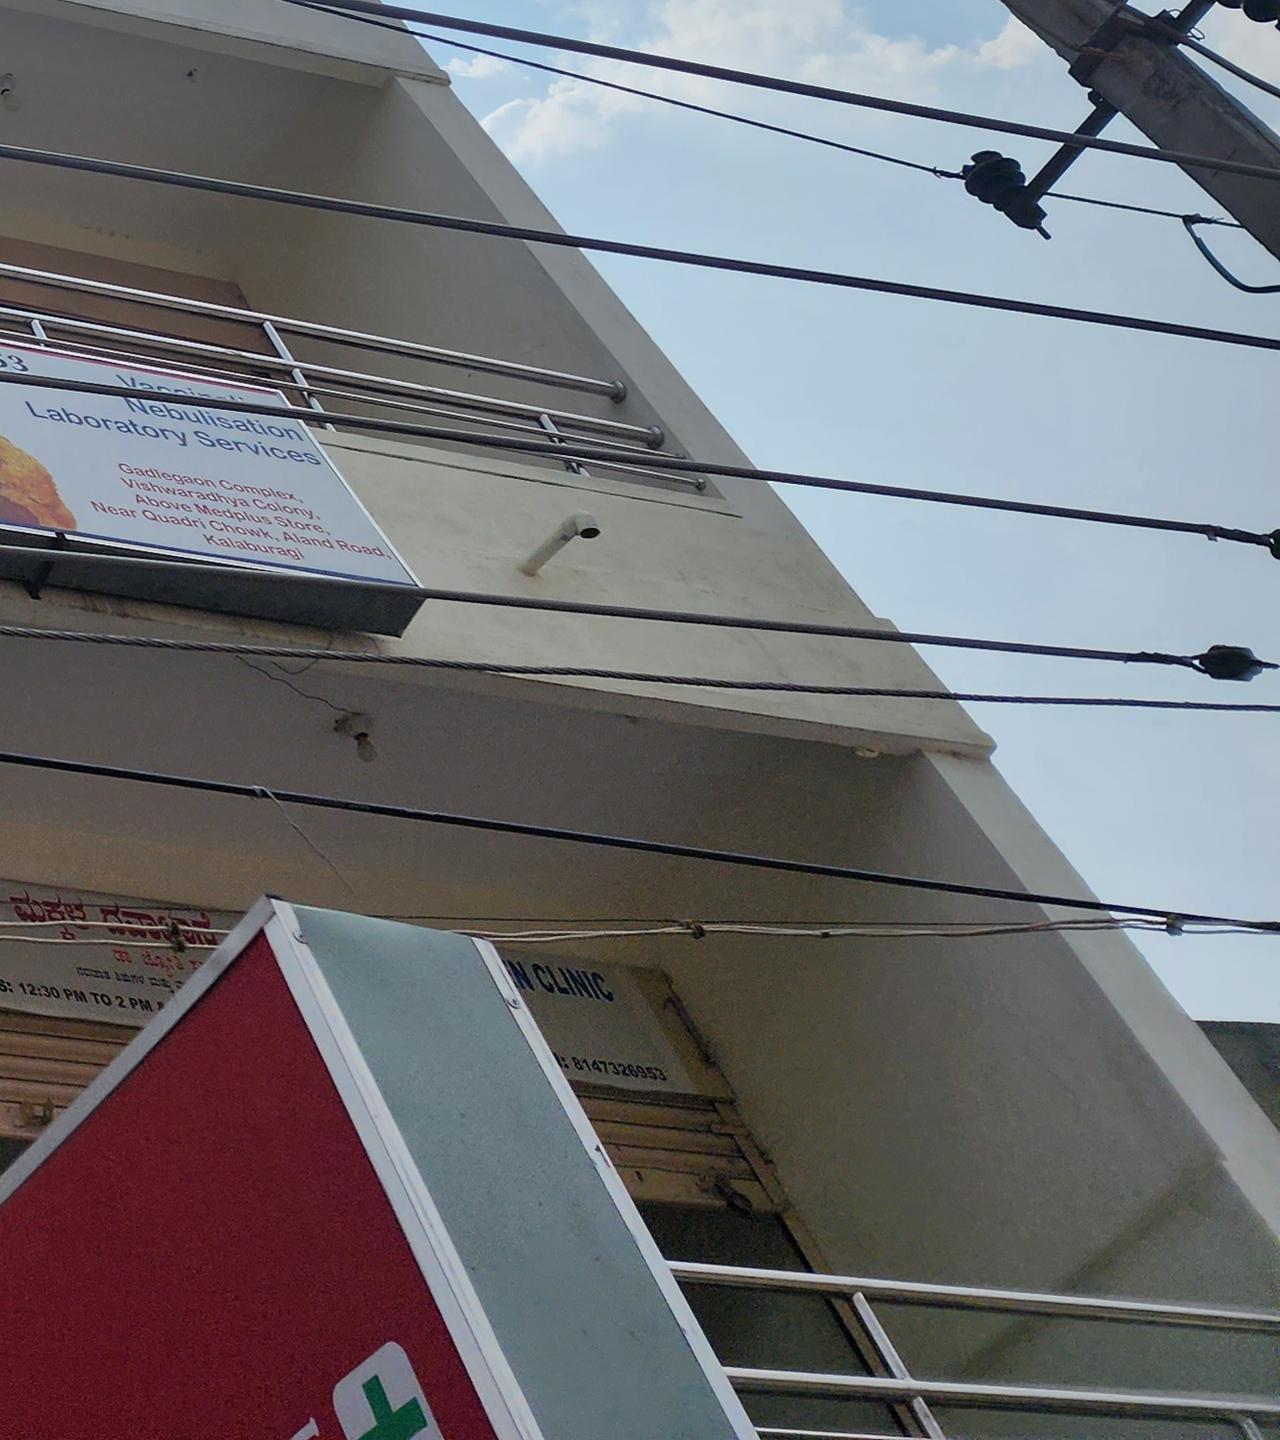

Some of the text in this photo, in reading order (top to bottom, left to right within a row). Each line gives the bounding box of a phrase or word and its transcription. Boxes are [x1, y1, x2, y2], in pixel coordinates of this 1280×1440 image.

[24, 400, 321, 466] Laboratory Services
[124, 397, 304, 442] Nebulisation
[118, 463, 304, 504] Gadlegaon Complex,
[120, 476, 321, 521] Vishwaradhya Colony,
[90, 500, 137, 519] Near
[142, 509, 207, 530] Quadri
[209, 519, 280, 542] Chowk,
[282, 531, 334, 550] Aland
[135, 494, 330, 536] Above Medplus Store,
[203, 533, 304, 560] Kalaburagi
[17, 982, 60, 1000] 12:30
[63, 988, 88, 1003] PM
[89, 992, 112, 1007] TO
[115, 995, 126, 1008] 2
[128, 996, 153, 1012] PM
[531, 963, 614, 1002] CLINIC
